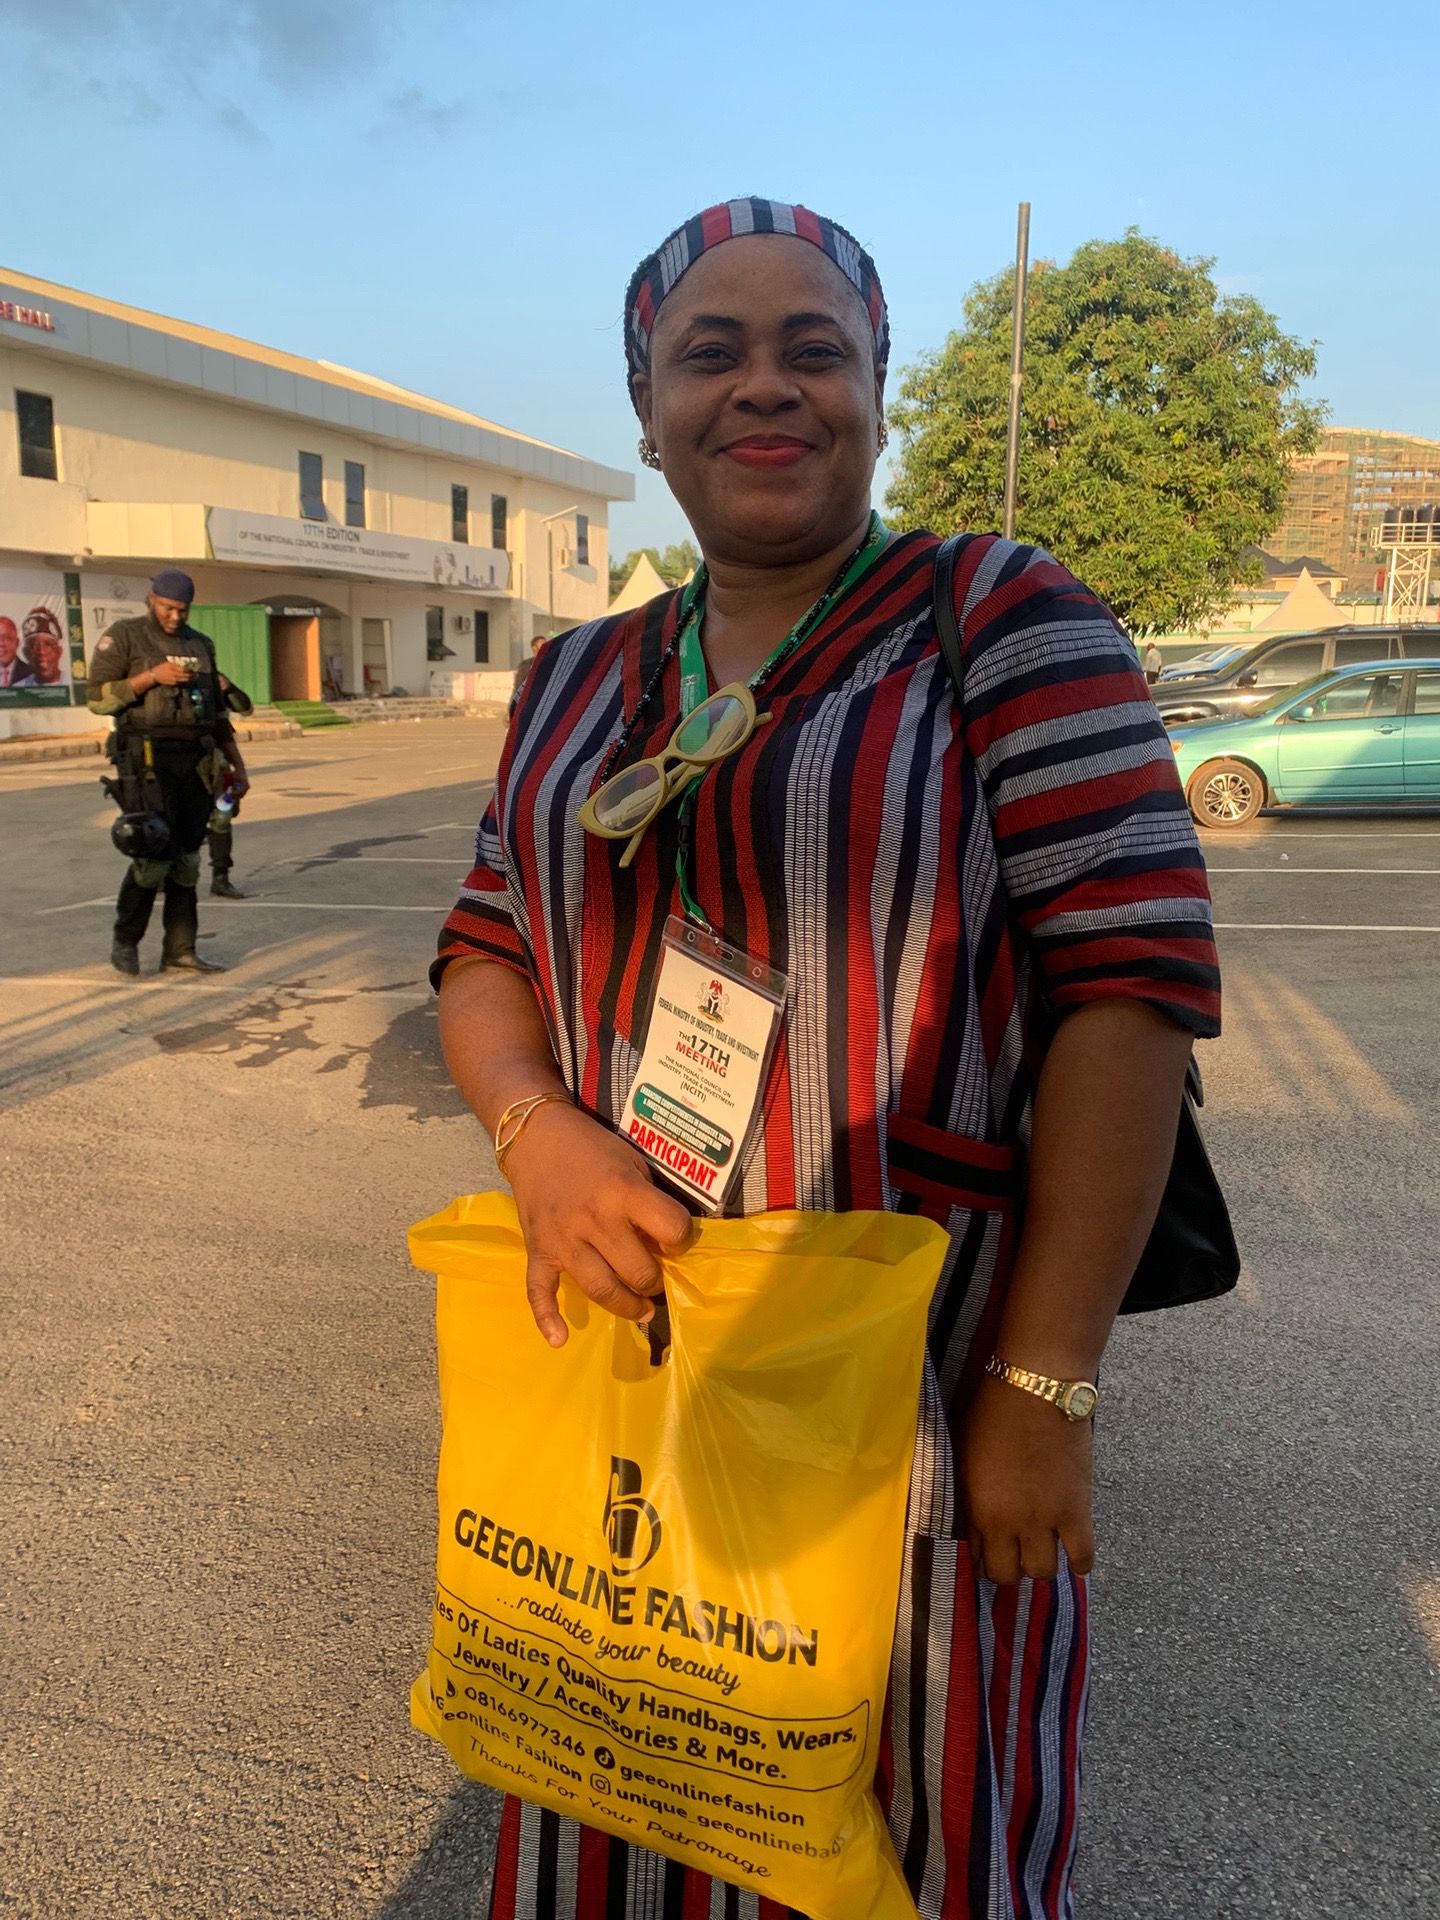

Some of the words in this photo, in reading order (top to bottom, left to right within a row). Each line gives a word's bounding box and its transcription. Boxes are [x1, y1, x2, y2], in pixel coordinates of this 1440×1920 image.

[326, 527, 360, 542] EDITION
[665, 1055, 675, 1064] THE
[675, 1061, 700, 1080] NATIONAL
[701, 1077, 722, 1093] COUNCIL
[723, 1090, 732, 1098] ON
[676, 1041, 727, 1078] MEETING
[678, 1031, 692, 1043] THE
[691, 1034, 731, 1068] 17TH
[658, 1059, 682, 1078] INDUSTRY,
[683, 1073, 699, 1087] TRADE
[703, 1086, 735, 1108] INVESTMENT
[680, 1081, 707, 1103] (NCITI)
[628, 1118, 718, 1191] PARTICIPANT
[454, 1508, 637, 1625] GEEONLINE
[644, 1586, 818, 1666] FASHION
[458, 1612, 479, 1637] Of
[483, 1625, 550, 1667] Ladies
[557, 1656, 631, 1714] Quality
[638, 1692, 767, 1750] Handbags,
[777, 1727, 857, 1751] Wears,
[595, 1635, 651, 1662] your
[656, 1643, 741, 1696] beauty
[453, 1642, 530, 1692] Jewelry
[535, 1676, 549, 1697] /
[553, 1684, 678, 1751] Accessories
[685, 1736, 708, 1760] &
[716, 1745, 787, 1779] More.
[464, 1687, 585, 1757] 08166977346
[620, 1765, 805, 1827] geeonlinefashion
[516, 1735, 582, 1782] Fashion
[470, 1735, 538, 1784] Thanks
[546, 1778, 579, 1800] For
[588, 1797, 637, 1825] Your
[646, 1820, 771, 1877] Patronage
